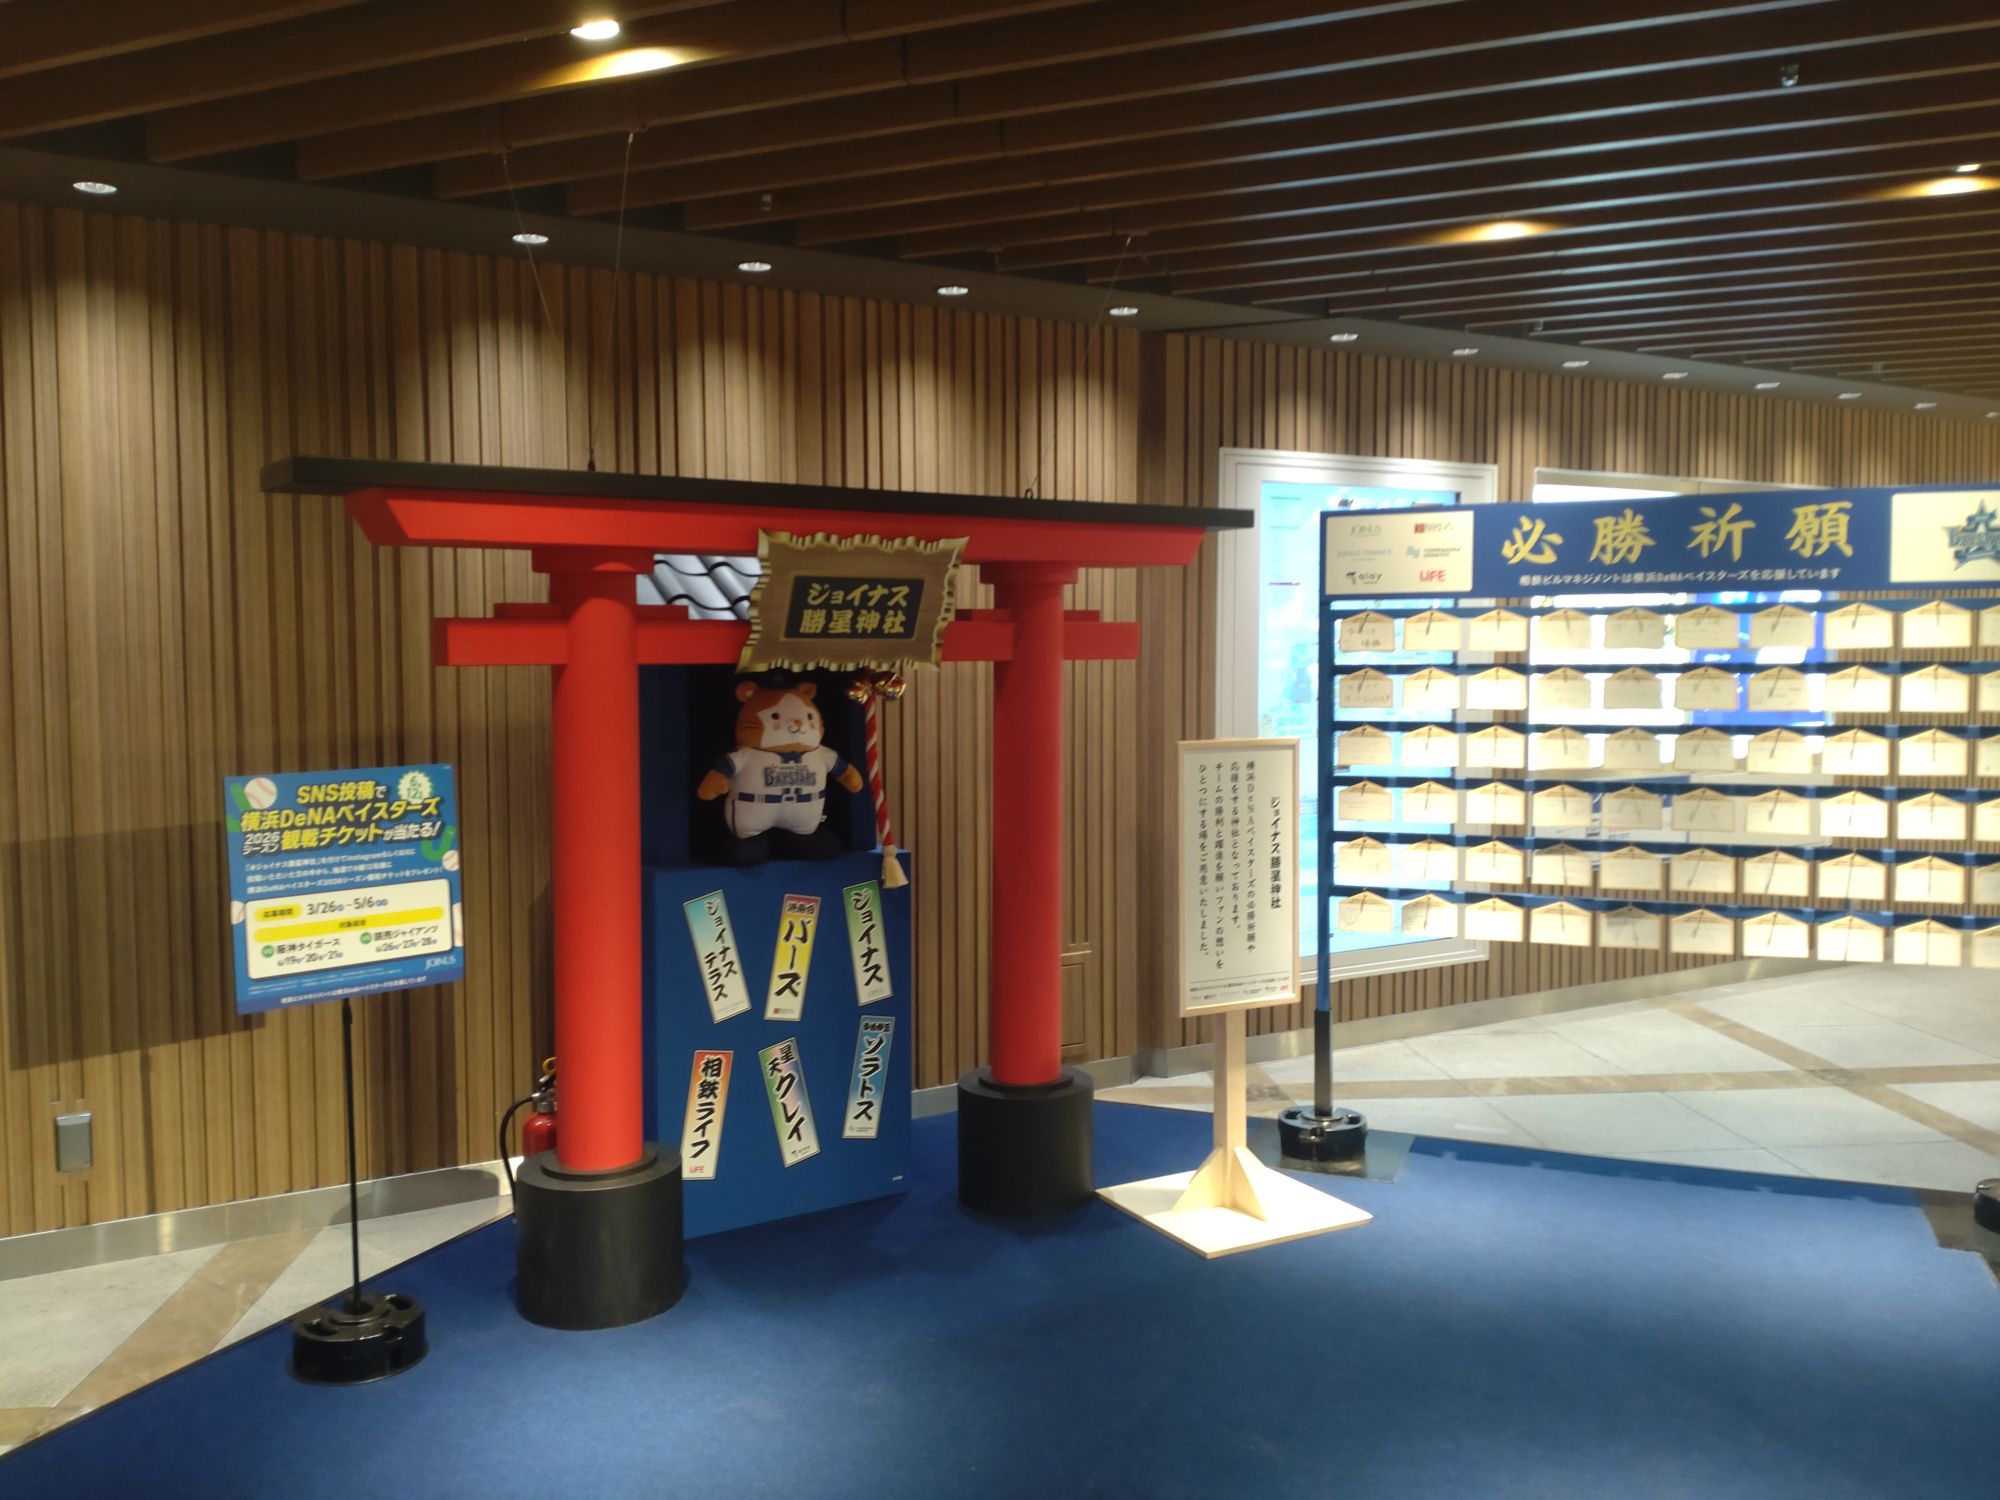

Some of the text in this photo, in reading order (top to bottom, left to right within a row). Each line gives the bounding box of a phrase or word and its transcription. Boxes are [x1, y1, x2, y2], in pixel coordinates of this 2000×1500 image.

[1502, 502, 1854, 565] 必勝祈願
[1419, 569, 1447, 583] LIFE
[807, 584, 909, 607] ジョイナス
[800, 610, 906, 633] 勝星神社
[296, 780, 388, 805] SNS投稿で
[241, 798, 439, 832] 横浜DeNAベイスターズ
[242, 843, 279, 856] シーズン
[244, 831, 281, 846] 2026
[706, 902, 737, 978] ジョイナス
[854, 891, 885, 987] ジョイナス
[776, 920, 812, 997] バーズ
[703, 951, 729, 1003] テラス
[853, 1034, 886, 1122] ソラトス
[690, 1057, 724, 1159] 相鉄ライフ
[688, 1165, 705, 1174] LIFE
